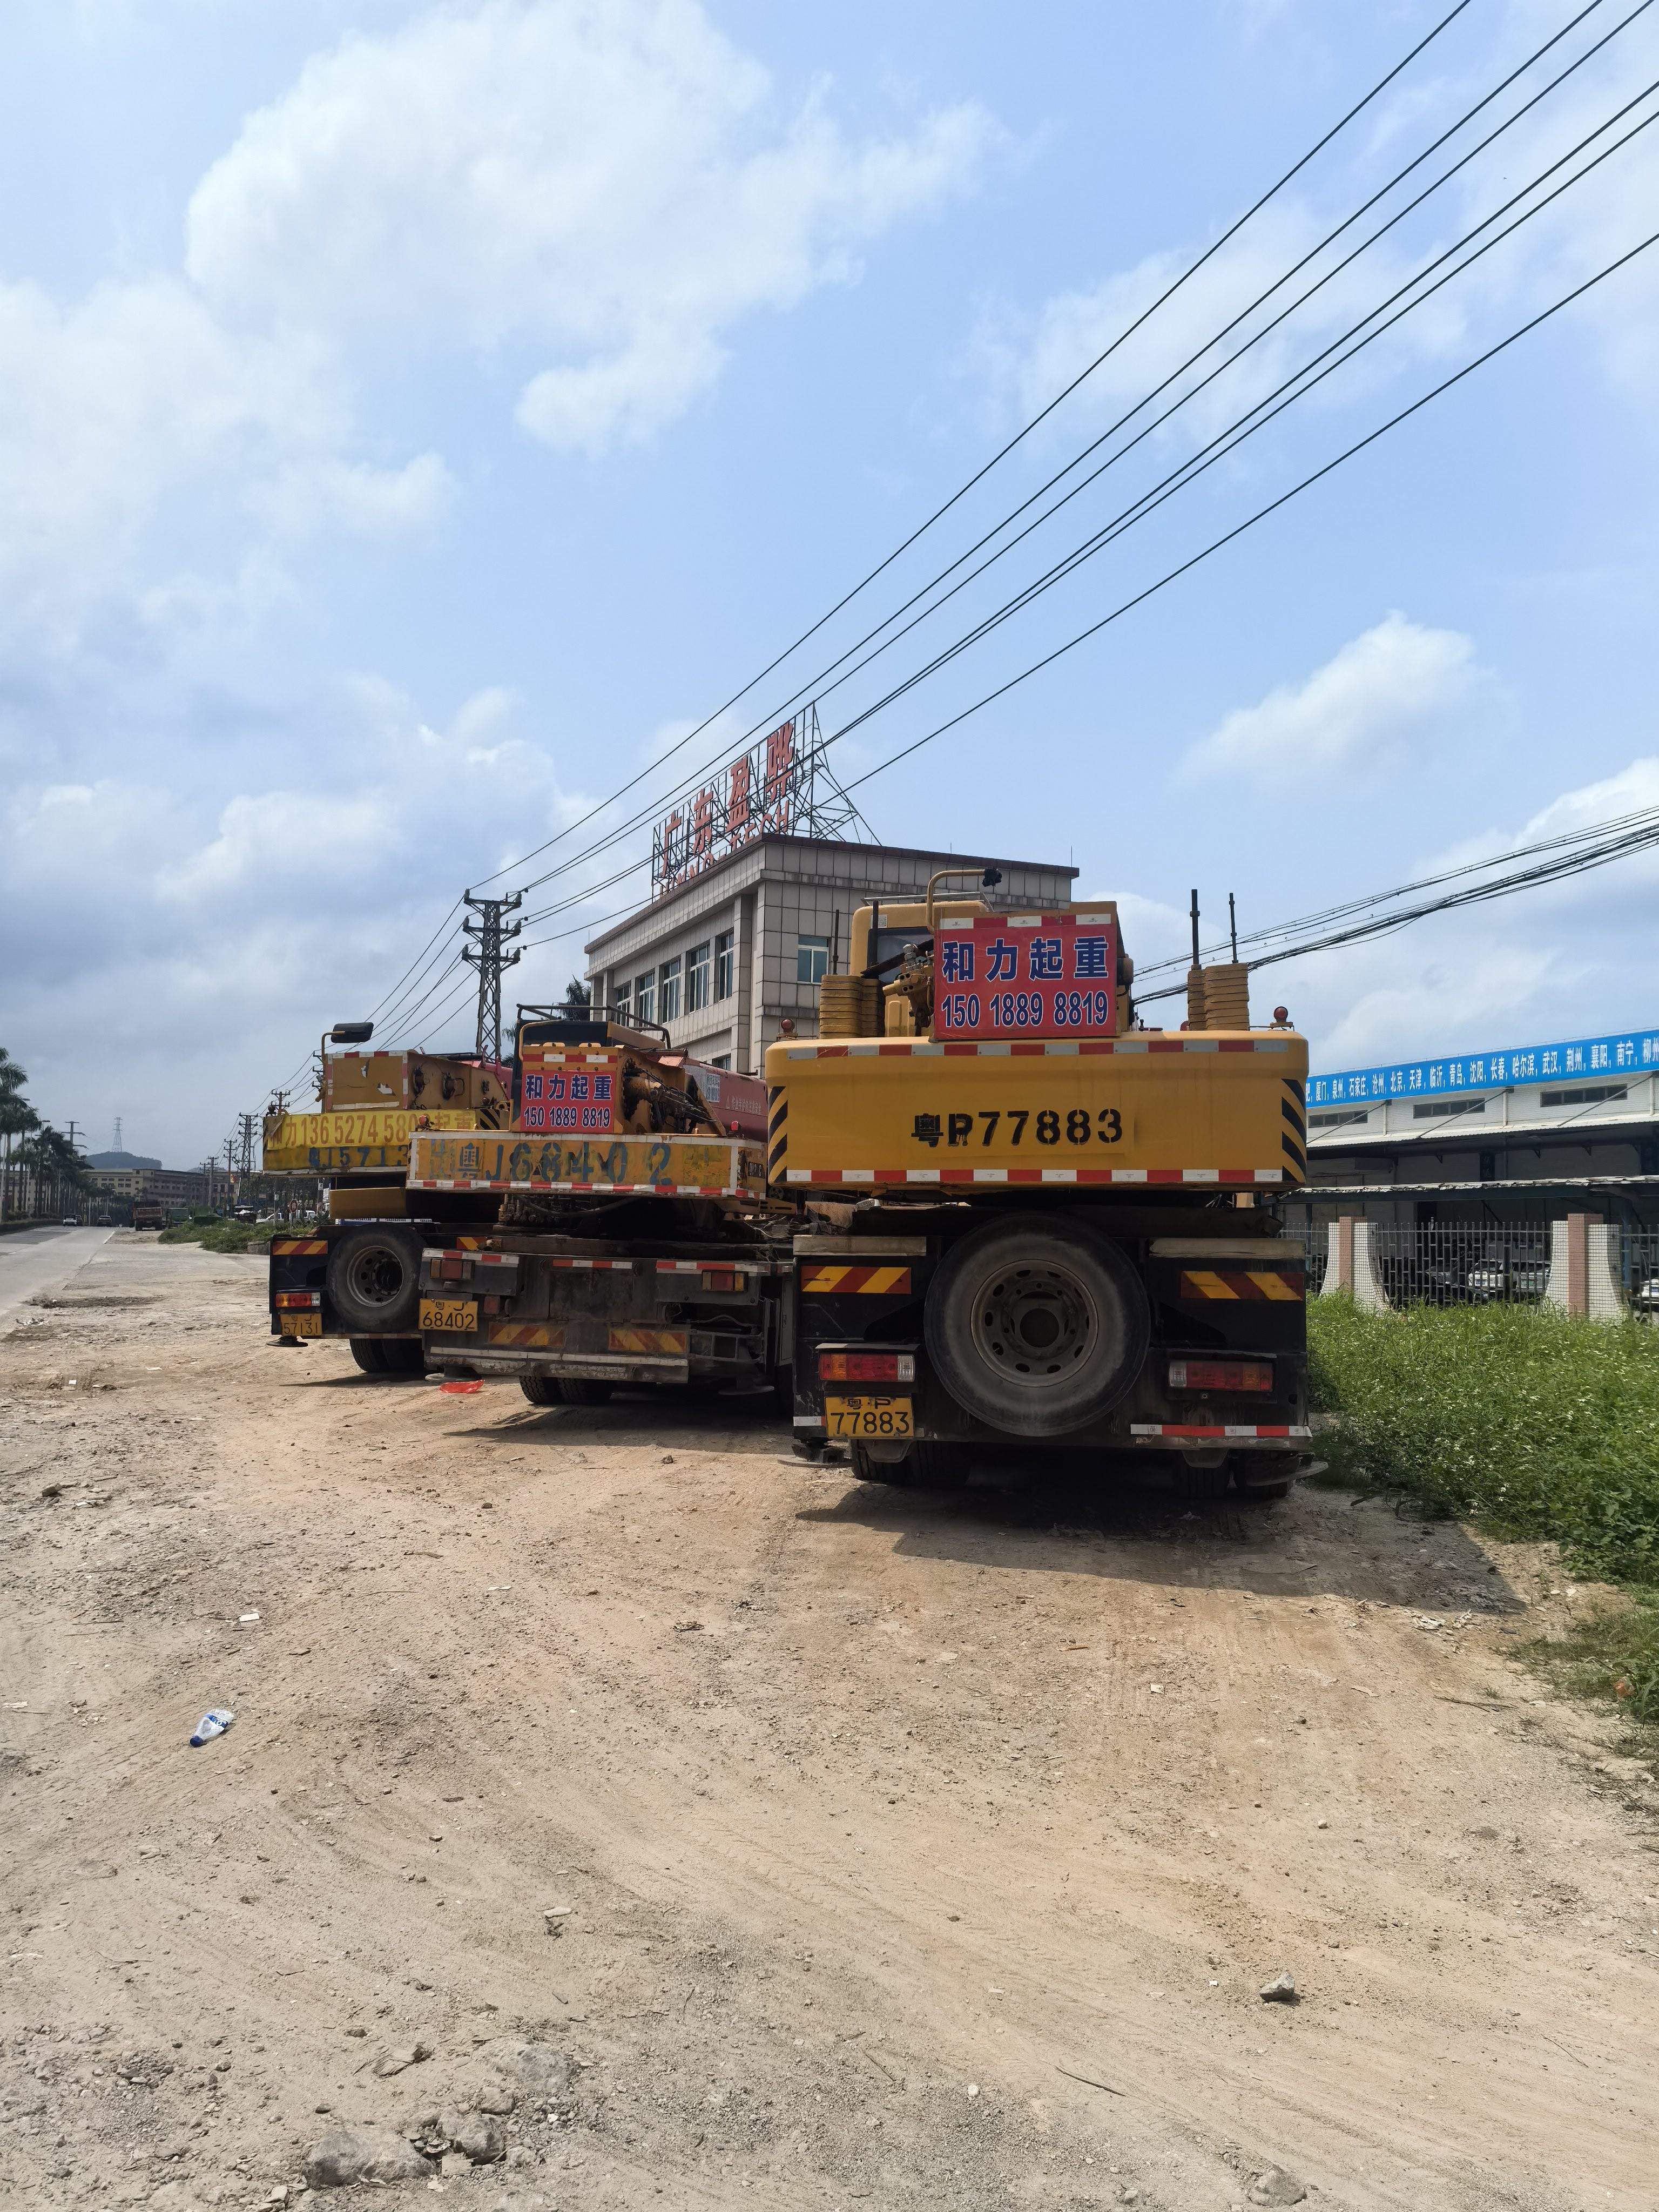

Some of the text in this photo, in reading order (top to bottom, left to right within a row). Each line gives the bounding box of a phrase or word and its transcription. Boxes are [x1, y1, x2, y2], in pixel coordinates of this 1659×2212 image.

[942, 936, 1109, 983] 和力起重
[941, 990, 1109, 1028] 150 1889 8819
[525, 1074, 612, 1101] 和力起重
[301, 1116, 329, 1145] 136
[334, 1115, 379, 1144] 5274
[524, 1106, 611, 1128] 150 1889 8819
[911, 1108, 1123, 1148] 粤P77883
[284, 1321, 319, 1334] 57131
[423, 1311, 475, 1330] 68402
[830, 1411, 910, 1434] 77883
